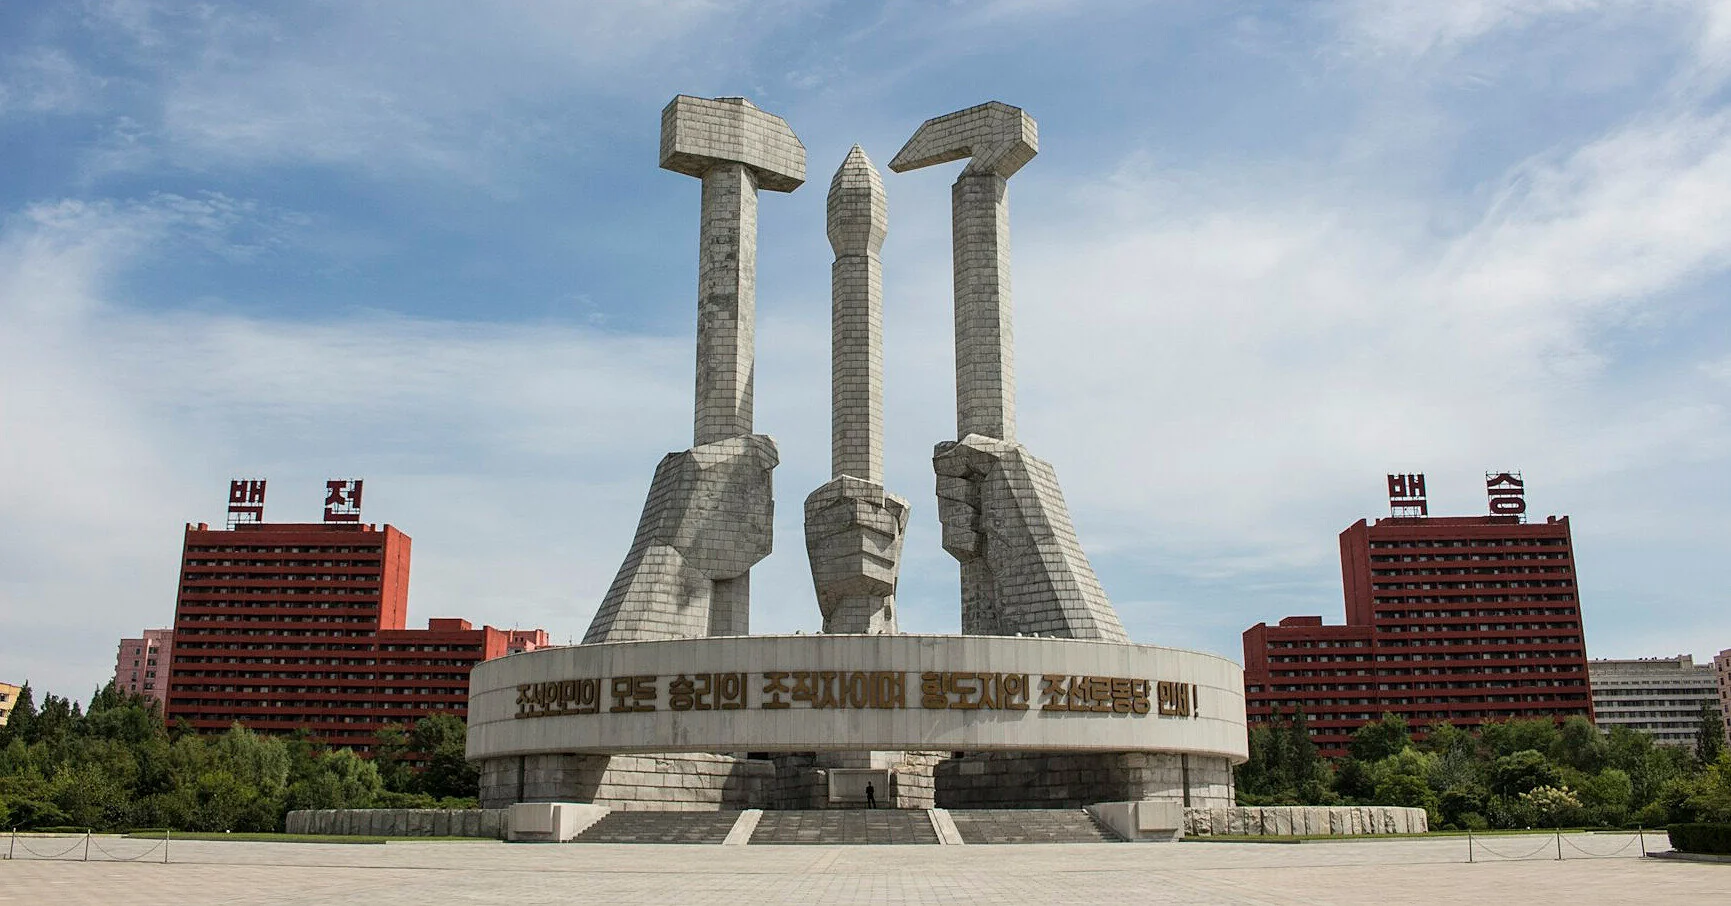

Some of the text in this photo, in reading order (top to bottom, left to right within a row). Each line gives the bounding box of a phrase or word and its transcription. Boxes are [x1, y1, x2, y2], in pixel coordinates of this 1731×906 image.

[515, 678, 601, 719] 조선인민의
[609, 675, 657, 713] 모든
[669, 672, 748, 711] 승리의
[762, 671, 906, 710] 조직자이며
[921, 671, 1030, 710] 향도자인
[1042, 674, 1152, 714] 조선로동당
